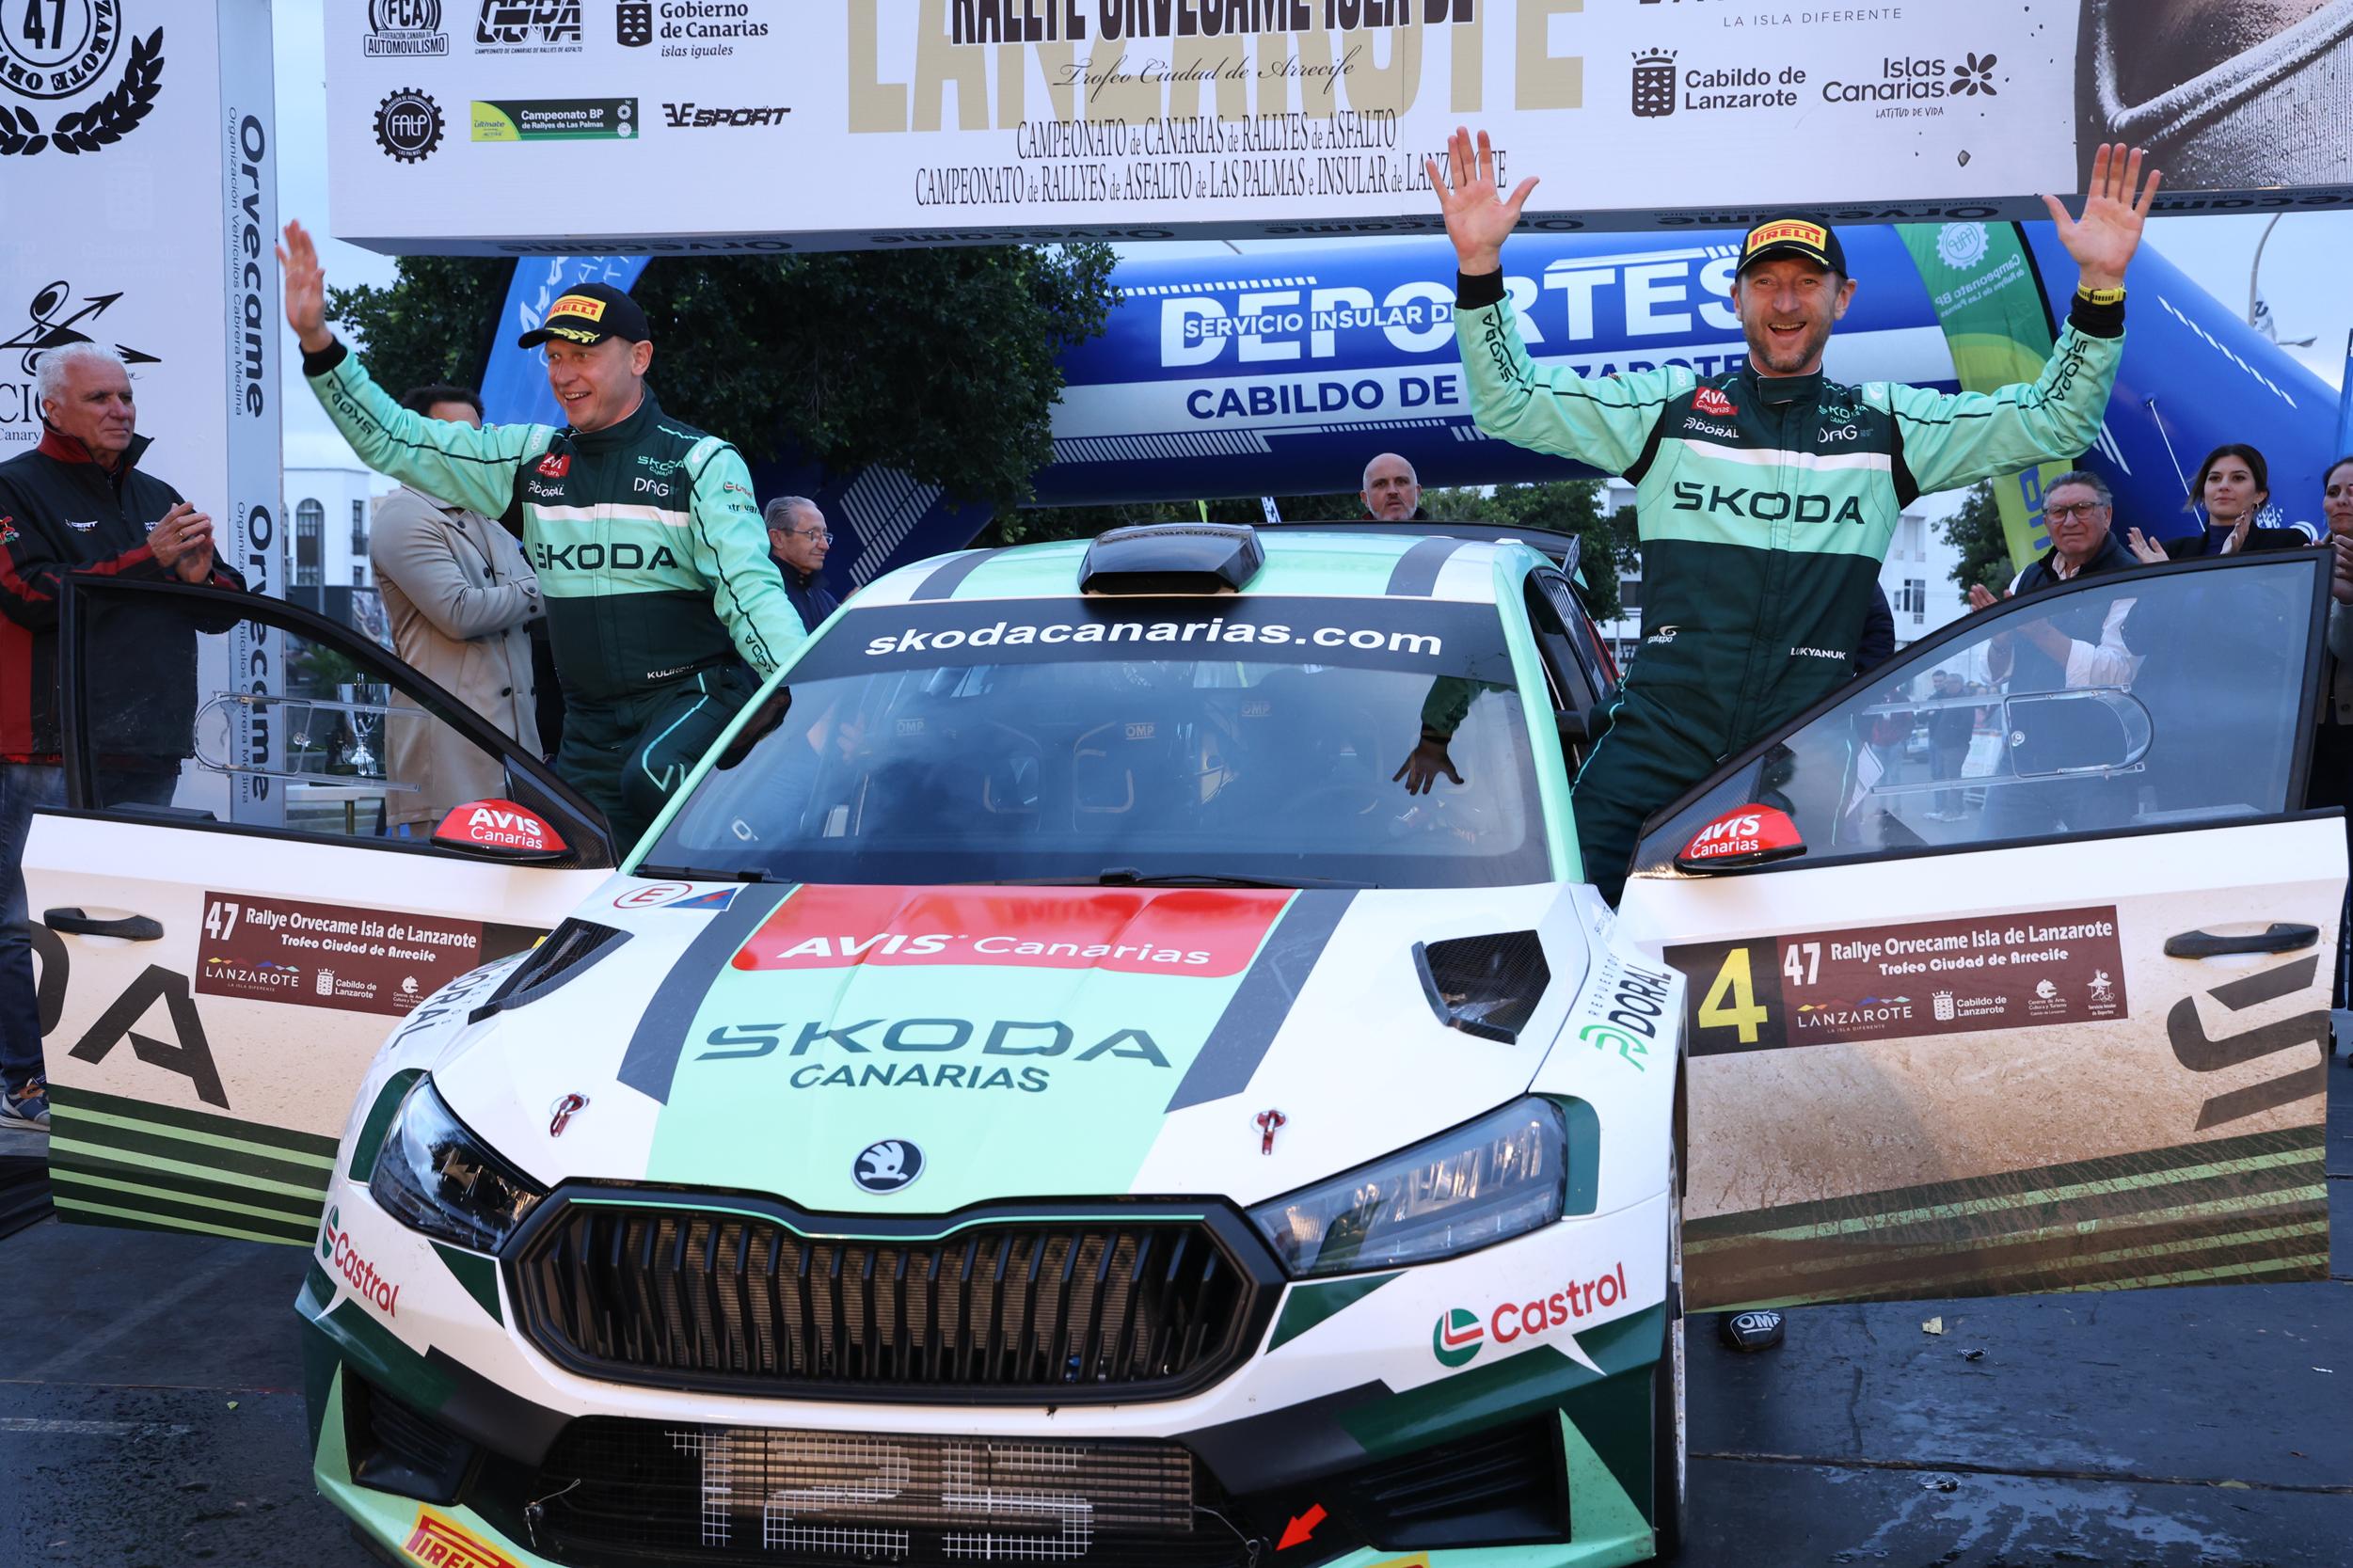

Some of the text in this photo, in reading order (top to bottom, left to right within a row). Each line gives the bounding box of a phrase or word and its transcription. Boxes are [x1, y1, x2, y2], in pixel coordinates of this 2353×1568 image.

[388, 0, 425, 27] FCA
[660, 1, 748, 19] Gobierno
[1723, 8, 1903, 28] LA ISLA DIFERENTE
[24, 0, 66, 50] 47
[660, 20, 769, 39] de Canarias
[368, 40, 445, 54] AUTOMOVILISMO
[661, 44, 734, 59] islas iguales
[1052, 44, 1362, 103] Trofeo Ciudad de Arrecife
[1684, 66, 1806, 88] Cabildo de
[1883, 55, 1946, 79] Islas
[1685, 88, 1798, 110] Lanzarote
[1821, 77, 1947, 103] Canarias
[520, 109, 604, 121] Campeonato BP
[1913, 106, 1923, 118] DE
[1925, 105, 1945, 118] VIDA
[532, 121, 555, 131] Rallyes
[556, 121, 566, 130] de
[566, 120, 579, 129] Las
[579, 120, 604, 129] Palmas
[1017, 108, 1396, 160] CAMPEONATO de CANARIAS de RALLYES de ASFALTO
[915, 166, 1025, 206] CAMPEONATO
[1027, 175, 1039, 203] de
[1041, 163, 1106, 203] RALLYES
[1109, 173, 1121, 201] de
[1124, 161, 1192, 202] ASFALTO
[1195, 170, 1206, 199] de
[1210, 159, 1239, 198] LAS
[1242, 157, 1306, 198] PALMAS
[1309, 174, 1314, 195] e
[1316, 154, 1387, 196] INSULAR
[1391, 166, 1403, 194] de
[1751, 223, 1820, 248] PIRELLI
[229, 106, 243, 416] Organización Vehículos Cabrera Medina
[240, 114, 265, 419] Orvecame
[548, 298, 598, 317] IRELLI
[1184, 313, 1304, 339] SERVICIO
[1311, 305, 1423, 330] INSULAR
[1186, 374, 1459, 420] CABILDO DE
[1696, 421, 1740, 438] DORAL
[1672, 481, 1866, 525] SKODA
[534, 543, 678, 571] SKODA
[863, 616, 1443, 658] skodacanarias.com
[1790, 647, 1847, 660] LUKYANUK
[1125, 723, 1156, 738] OMP
[469, 808, 541, 836] AVIS
[1693, 814, 1762, 847] AVIS
[470, 826, 543, 849] Canarias
[1691, 836, 1759, 859] Canarias
[628, 887, 676, 903] E
[205, 900, 477, 948] 47 Rallye Orvecame Isla de Lanzarote
[282, 933, 437, 962] Trofeo Ciudad de Arrecife
[776, 933, 1211, 965] AVIS Canarias
[1784, 921, 2113, 987] 47 Rallye Orvecame Isla de Lanzarote
[1879, 948, 2070, 977] Trofeo Ciudad de Arrecife
[205, 965, 299, 988] LANZAROTE
[336, 978, 376, 990] Cabildo de
[335, 988, 374, 999] Lanzarote
[1607, 962, 1672, 1039] DORAL
[1697, 947, 1768, 1043] 4
[1957, 995, 2007, 1009] Cabildo de
[1796, 1005, 1913, 1029] LANZAROTE
[1957, 1005, 2005, 1018] Lanzarote
[692, 1017, 1173, 1069] SKODA
[788, 1063, 1051, 1094] CANARIAS
[333, 1230, 400, 1318] Castrol
[1489, 1261, 1628, 1344] Castrol
